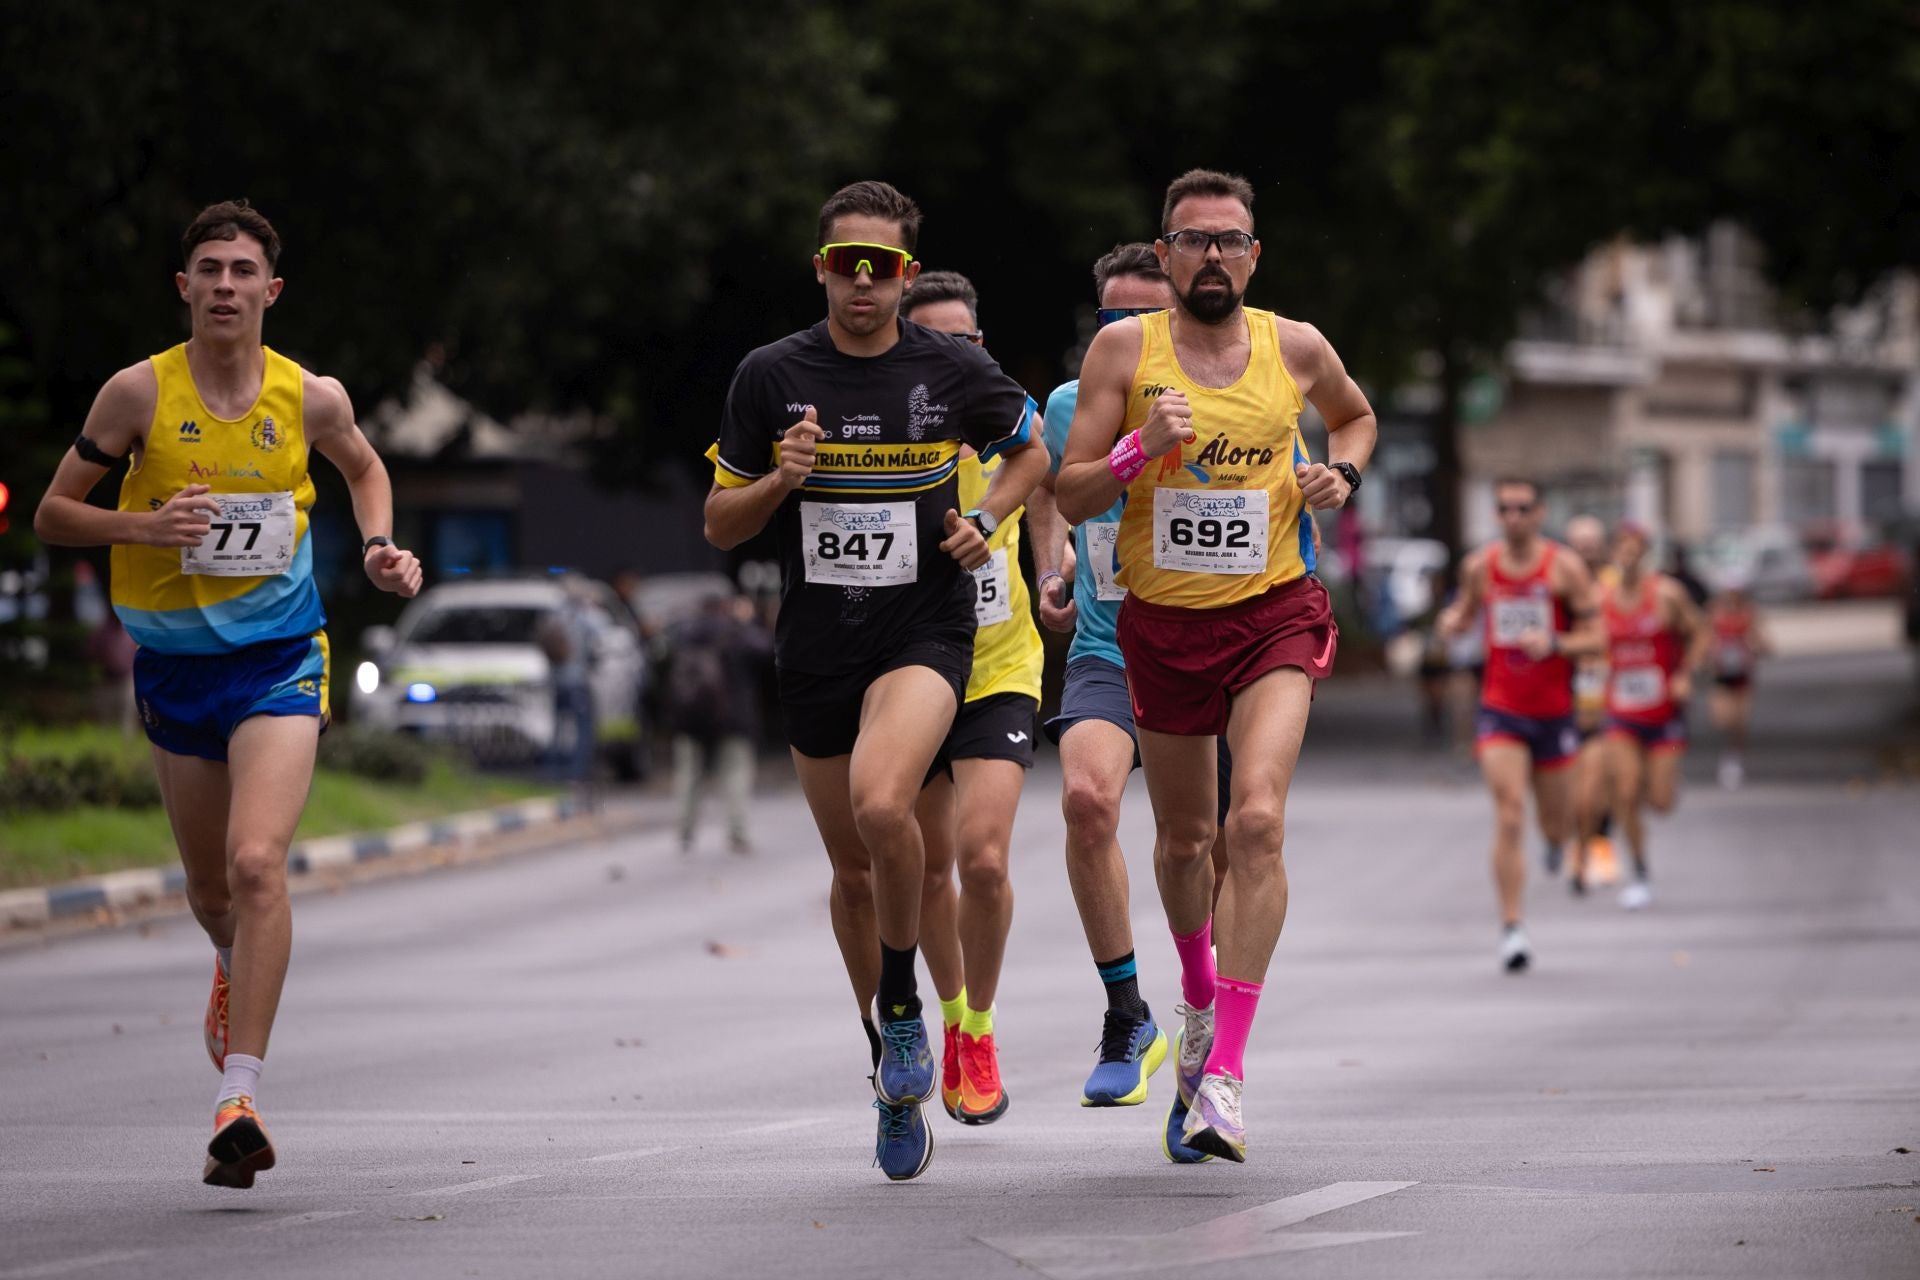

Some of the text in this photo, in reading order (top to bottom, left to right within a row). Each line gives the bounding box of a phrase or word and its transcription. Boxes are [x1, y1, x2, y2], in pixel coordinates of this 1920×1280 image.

[1144, 383, 1175, 398] vív
[842, 425, 881, 439] gross
[815, 448, 941, 467] TRIATLÓN MÁLAGA
[1196, 432, 1273, 466] Álora
[210, 523, 261, 550] 77
[818, 532, 894, 560] 847
[1170, 518, 1250, 548] 692
